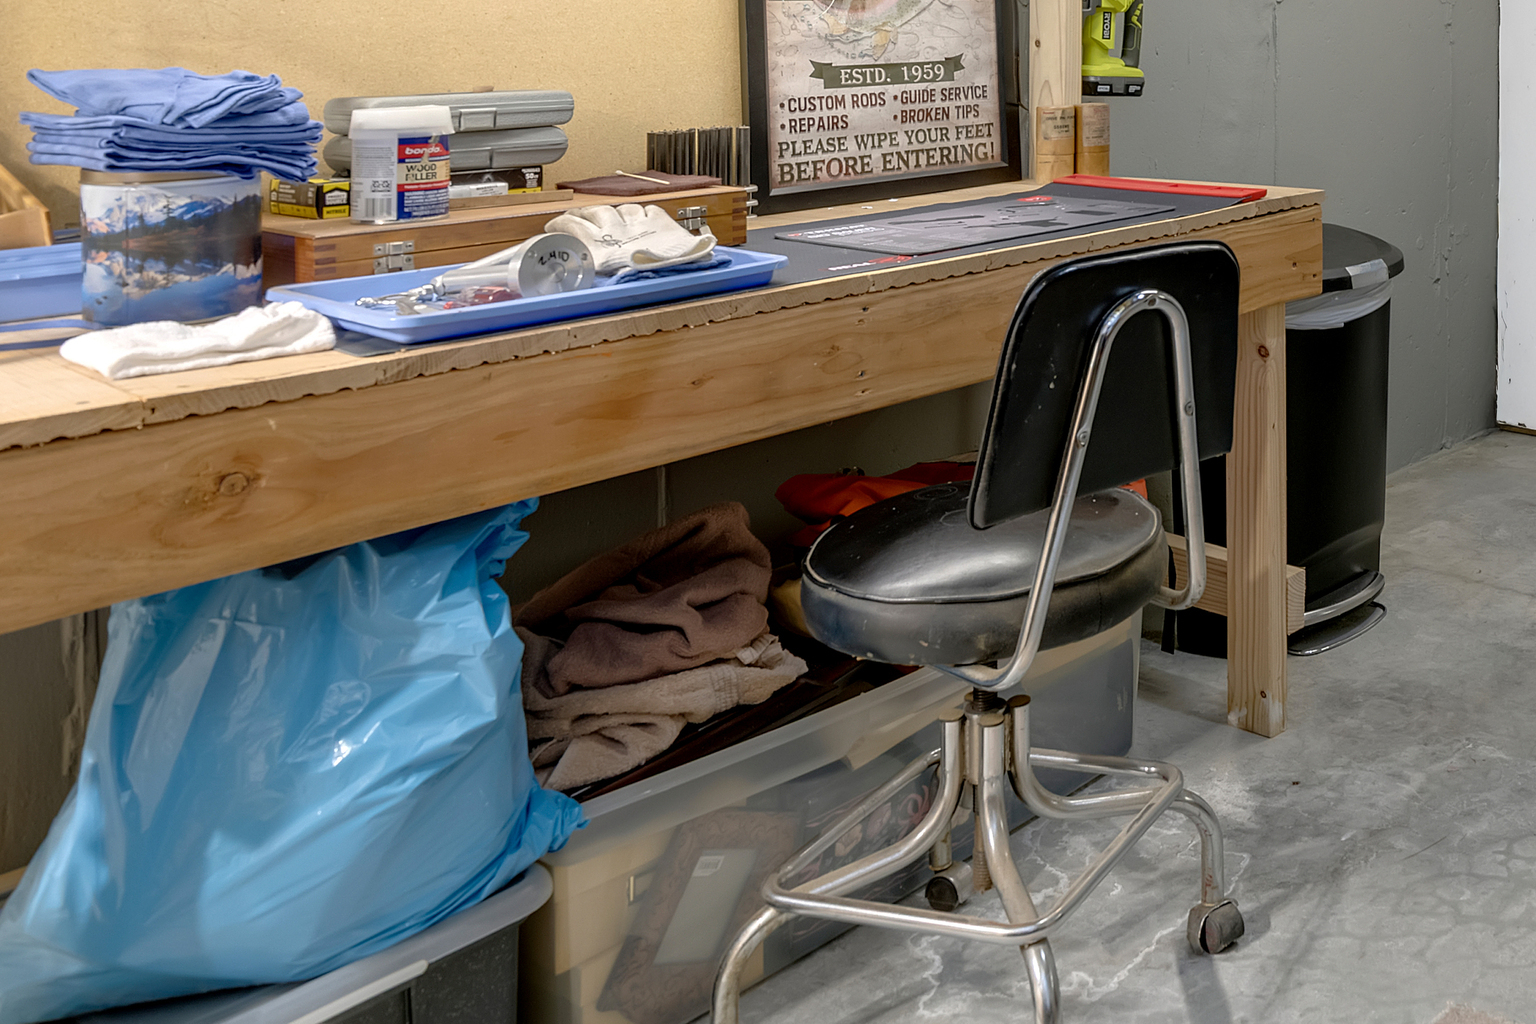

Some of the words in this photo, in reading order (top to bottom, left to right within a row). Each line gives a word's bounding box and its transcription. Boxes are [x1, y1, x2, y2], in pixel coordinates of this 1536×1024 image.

[840, 67, 891, 85] ESTD.
[901, 63, 945, 81] 1959
[787, 94, 846, 113] CUSTOM
[851, 92, 886, 109] RODS
[900, 88, 936, 104] GUIDE
[941, 85, 988, 100] SERVICE
[788, 114, 849, 134] REPAIRS
[900, 106, 950, 124] BROKEN
[955, 104, 980, 120] TIPS
[778, 136, 849, 159] PLEASE
[854, 131, 900, 150] WIPE
[904, 127, 949, 145] YOUR
[955, 122, 994, 140] FEET
[405, 147, 440, 155] bondo
[406, 164, 437, 172] WOOD
[778, 154, 874, 184] BEFORE
[881, 141, 995, 172] ENTERING!
